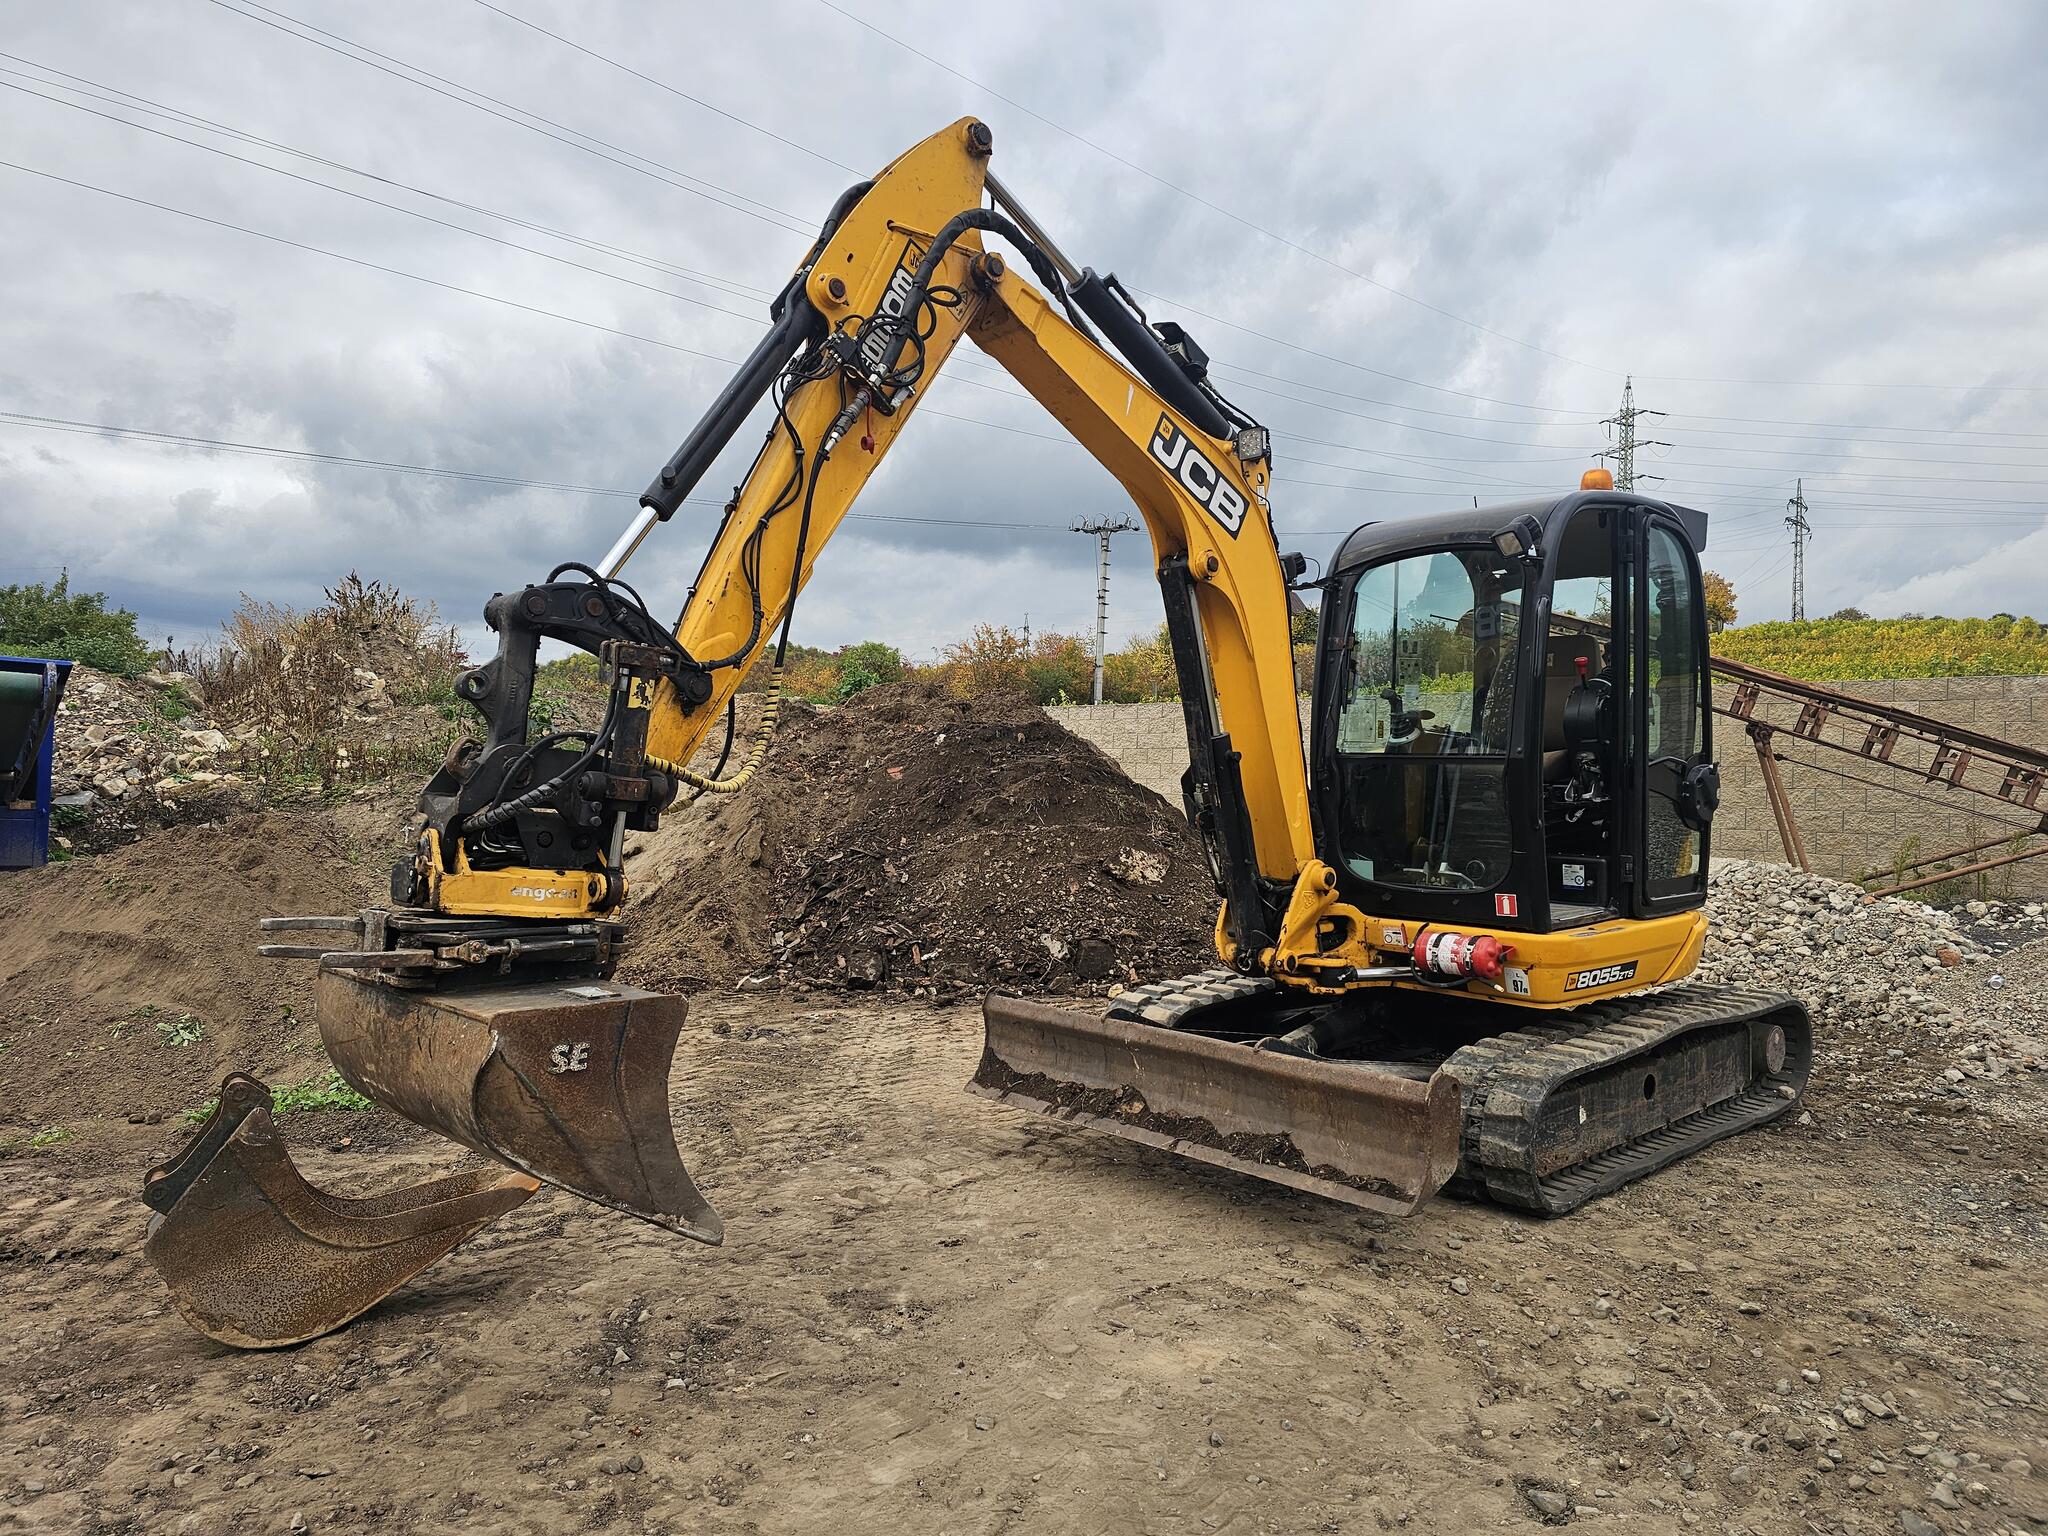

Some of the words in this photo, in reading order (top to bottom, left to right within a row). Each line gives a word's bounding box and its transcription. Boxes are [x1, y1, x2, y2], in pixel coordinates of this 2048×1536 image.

[1153, 434, 1245, 532] JCB
[1512, 979, 1523, 993] 97
[548, 1041, 591, 1075] SE
